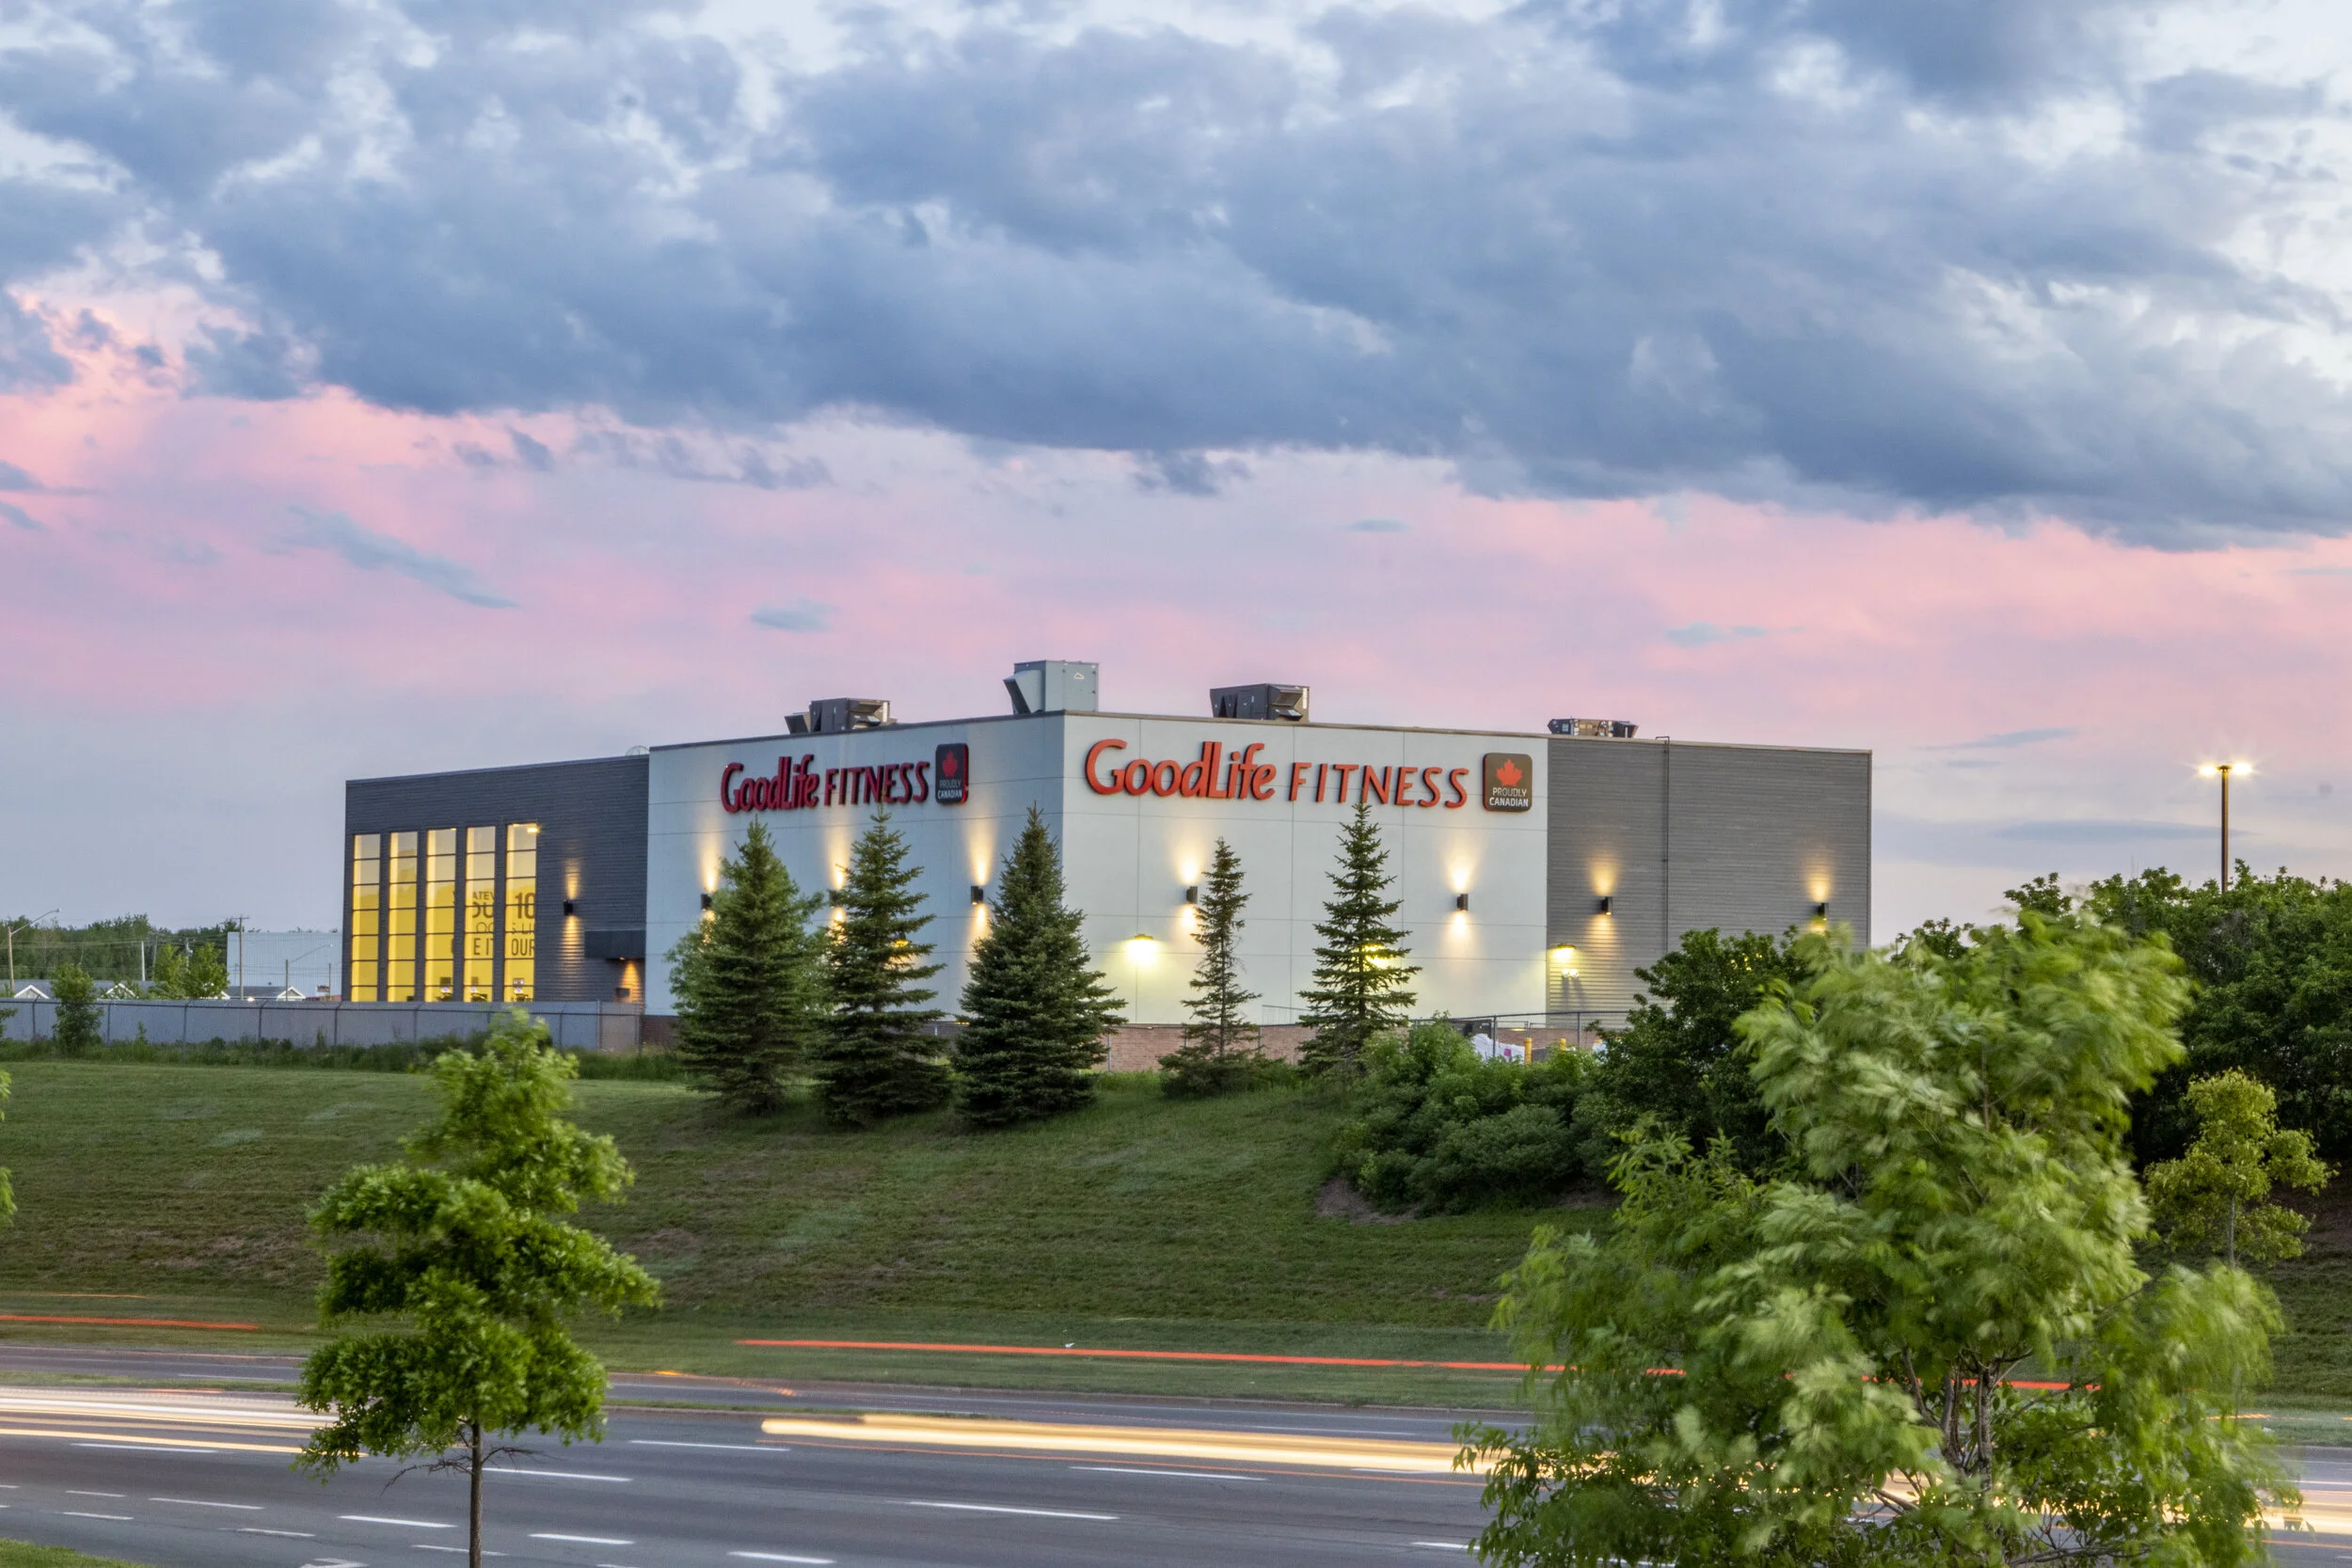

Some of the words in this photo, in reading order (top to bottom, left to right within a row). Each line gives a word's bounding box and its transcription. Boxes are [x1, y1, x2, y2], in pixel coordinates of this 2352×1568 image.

[824, 760, 930, 806] FITNESS
[940, 779, 961, 788] PROUDLY
[1289, 762, 1470, 810] FITNESS
[938, 789, 962, 799] CANADIAN
[1492, 786, 1527, 797] PROUDLY
[1489, 797, 1529, 807] CANADIAN
